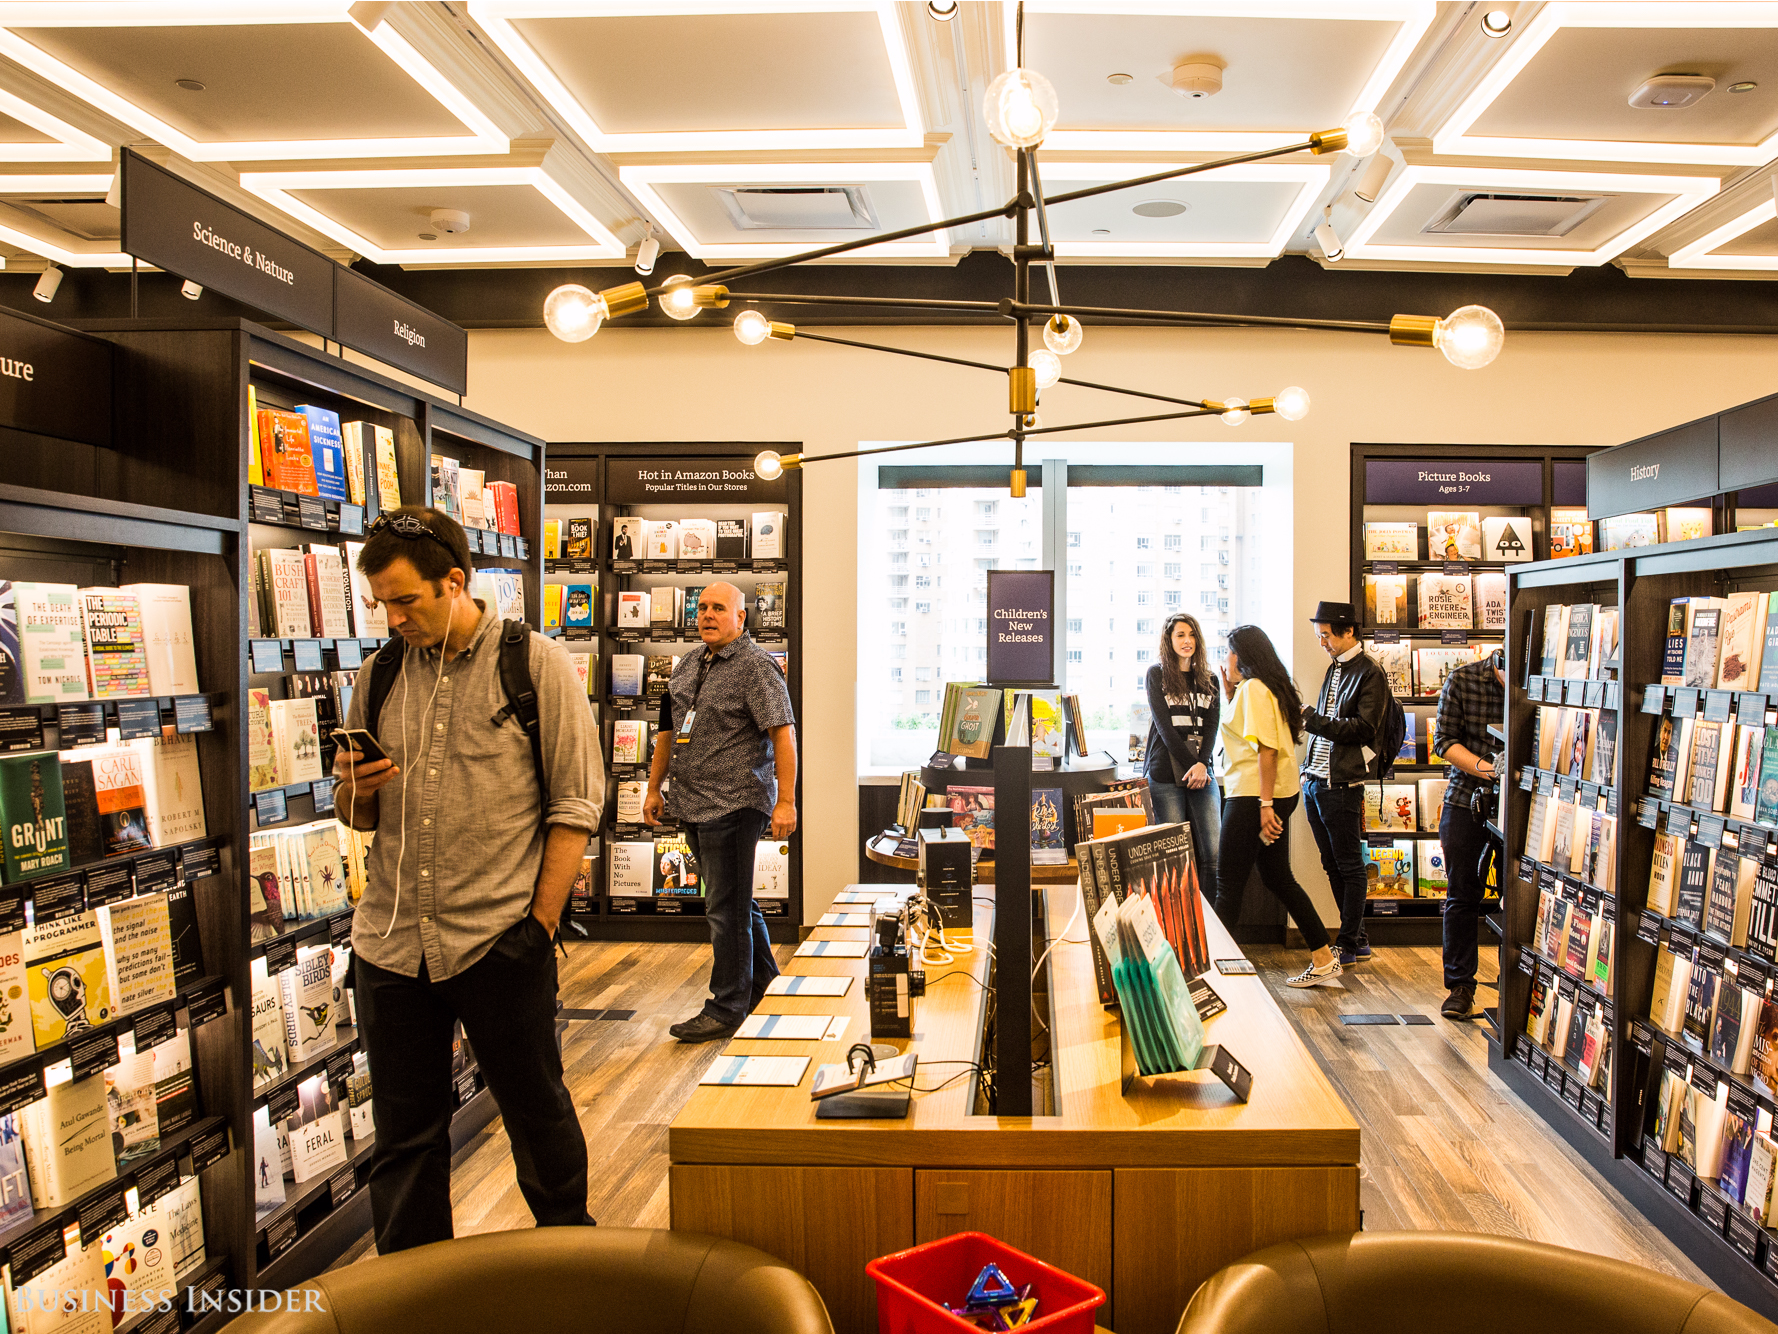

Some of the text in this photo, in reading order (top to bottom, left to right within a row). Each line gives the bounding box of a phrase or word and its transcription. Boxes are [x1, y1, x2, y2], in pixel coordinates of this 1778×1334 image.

[193, 221, 293, 285] Science & Nature
[394, 319, 425, 348] Religion
[0, 356, 34, 382] ure
[311, 424, 340, 437] AMERICAN
[313, 436, 341, 449] SICKNESS
[638, 470, 754, 480] Hot in Amazon Books
[1418, 472, 1491, 482] Picture Books
[1630, 463, 1660, 481] History
[380, 479, 394, 490] POOH
[645, 484, 674, 493] Popular
[274, 564, 304, 577] BUSH
[275, 578, 304, 589] CRAFT
[342, 568, 352, 611] EVOLUTION
[87, 596, 104, 611] THE
[278, 590, 292, 601] 101
[32, 603, 72, 613] THE DEATH
[994, 609, 1048, 619] Children's
[27, 616, 79, 626] OF EXPERTISE
[88, 612, 128, 626] PERIODIC
[1009, 621, 1033, 631] New
[90, 628, 117, 642] TABLE
[999, 633, 1043, 643] Releases
[1668, 639, 1683, 648] LIES
[38, 675, 80, 684] TOM NICHOLS
[961, 721, 979, 731] GHOST
[154, 733, 192, 747] BEHAVE
[1695, 728, 1718, 749] LOST
[1692, 746, 1713, 765] CITY
[100, 757, 135, 774] CARL
[98, 771, 139, 790] SAGAN
[1689, 776, 1713, 804] GOD
[161, 810, 191, 823] ROBERT
[11, 816, 64, 853] GRUNT
[164, 822, 202, 836] SAPOLSKY
[1128, 833, 1189, 859] UNDER PRESSURE
[1370, 848, 1405, 861] LEGEND
[20, 853, 63, 871] MARY ROACH
[1079, 851, 1091, 884] UNDER
[1094, 848, 1107, 882] UNDER
[1108, 847, 1121, 882] UNDER
[1683, 852, 1702, 868] BLACK
[1687, 870, 1704, 886] HAND
[1715, 878, 1731, 893] PEARL
[169, 890, 187, 902] EARTH
[1711, 892, 1732, 909] HARBOR
[33, 914, 83, 933] THINK LIKE
[33, 920, 96, 943] PROGRAMMER
[113, 920, 146, 934] the signal
[114, 926, 158, 944] and the noise
[117, 946, 158, 964] why so many
[118, 956, 153, 975] predictions
[119, 963, 166, 984] but some don't
[295, 953, 329, 977] SIBLEY
[302, 966, 331, 987] BIRDS
[1691, 964, 1707, 985] INTO
[121, 987, 155, 1004] nate silver
[1688, 983, 1699, 998] THE
[1685, 999, 1706, 1025] BLACK
[285, 1011, 298, 1048] BIRDS
[60, 1104, 104, 1130] Atul Gawande
[64, 1130, 106, 1156] Being Mortal
[305, 1129, 335, 1154] FERAL
[167, 1197, 197, 1220] The Laws
[170, 1217, 199, 1240] Medicine
